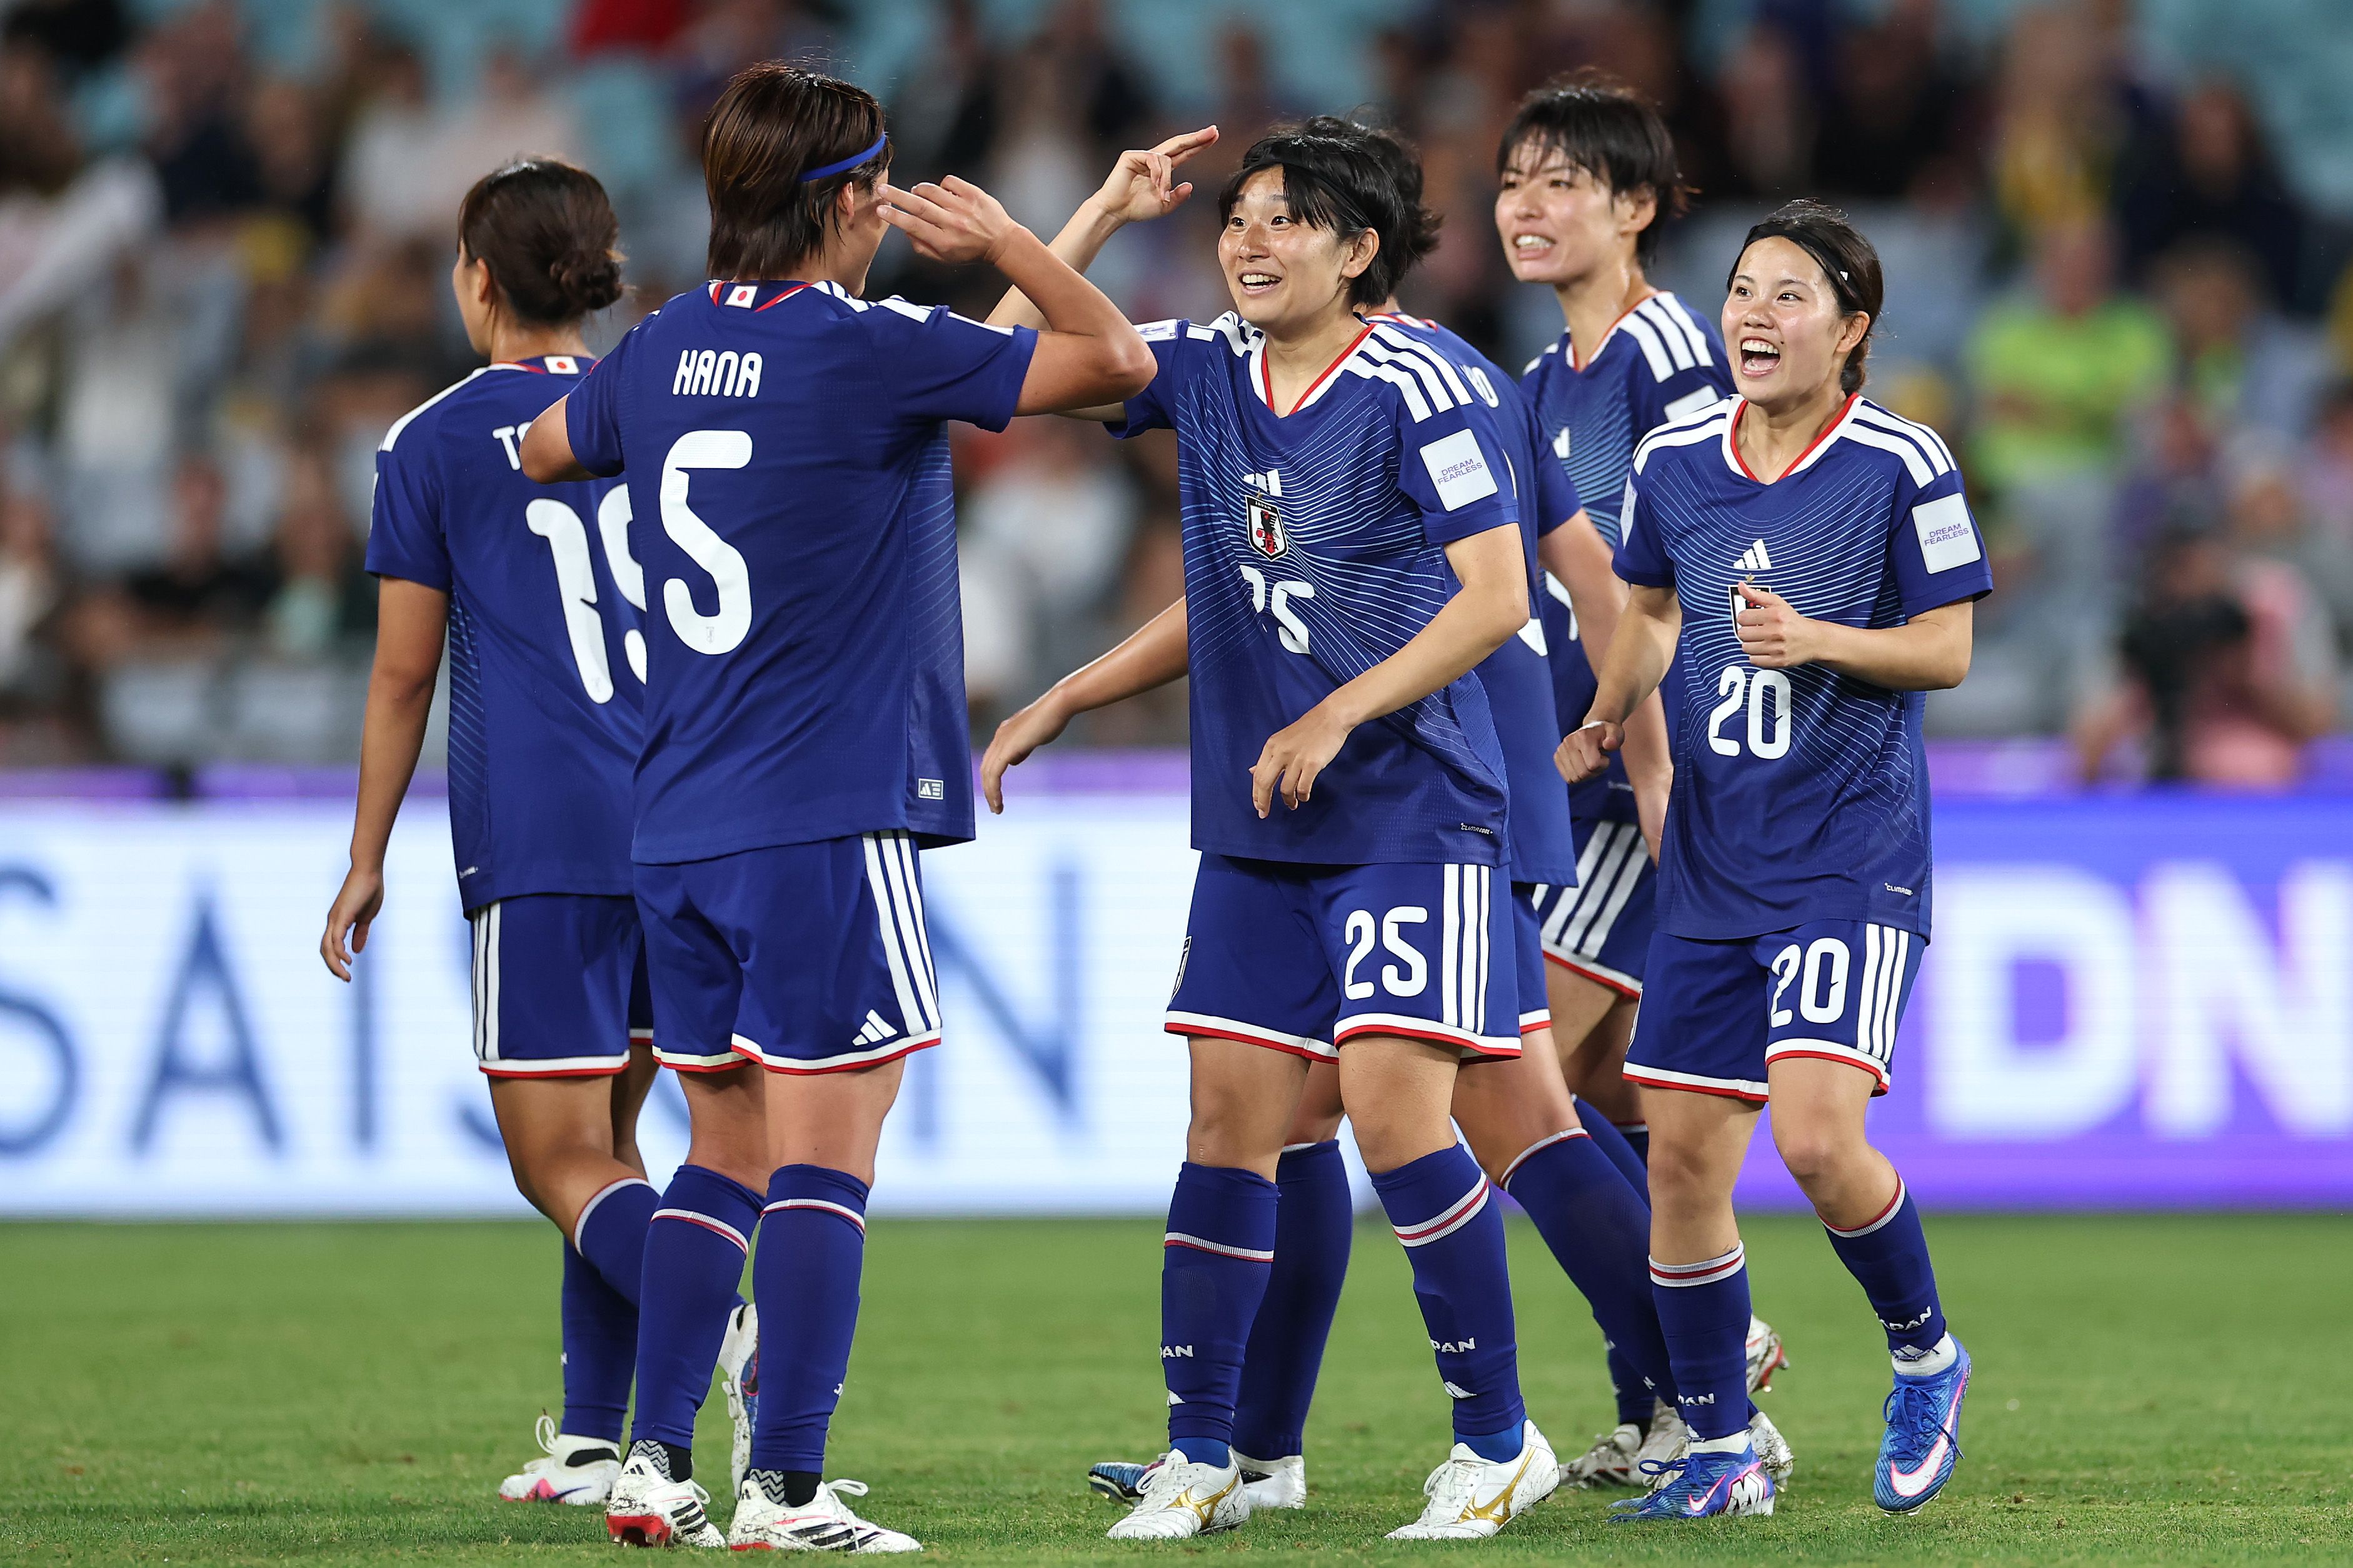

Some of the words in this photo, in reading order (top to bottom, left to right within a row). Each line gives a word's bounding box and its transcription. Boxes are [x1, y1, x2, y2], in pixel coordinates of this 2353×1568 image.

[672, 349, 763, 398] HANA
[1438, 462, 1483, 484] FEARLESS
[1442, 458, 1474, 476] DREAM
[660, 430, 753, 655] 5
[1924, 527, 1969, 546] FEARLESS
[1929, 523, 1961, 537] DREAM
[1708, 666, 1791, 759] 20
[1344, 906, 1428, 1001] 25
[1770, 937, 1851, 1029] 20
